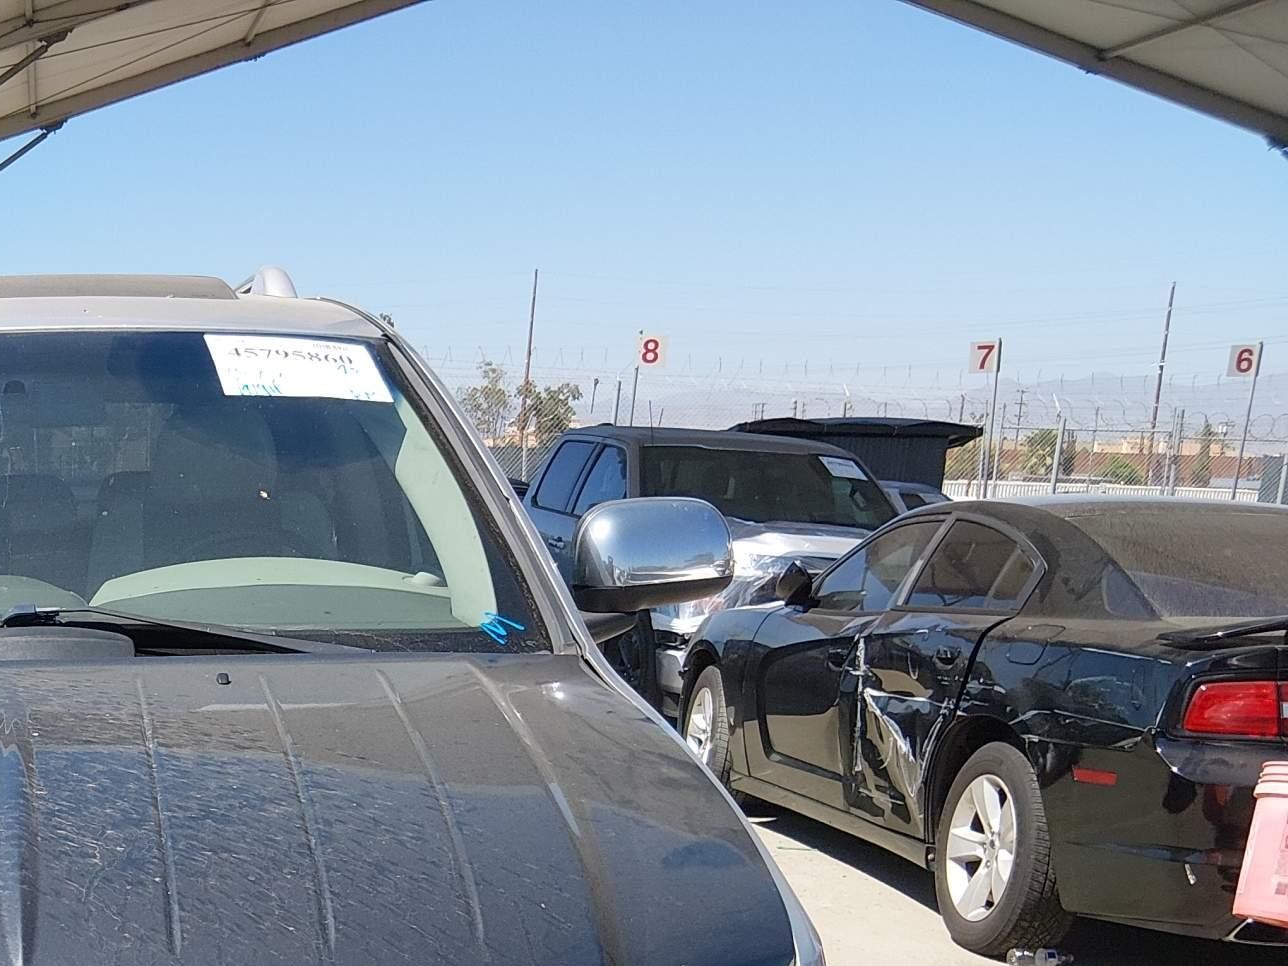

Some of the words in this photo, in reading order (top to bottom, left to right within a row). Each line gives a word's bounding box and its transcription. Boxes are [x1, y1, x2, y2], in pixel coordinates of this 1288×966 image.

[641, 338, 660, 364] 8
[976, 344, 996, 370] 7
[1235, 348, 1254, 373] 6
